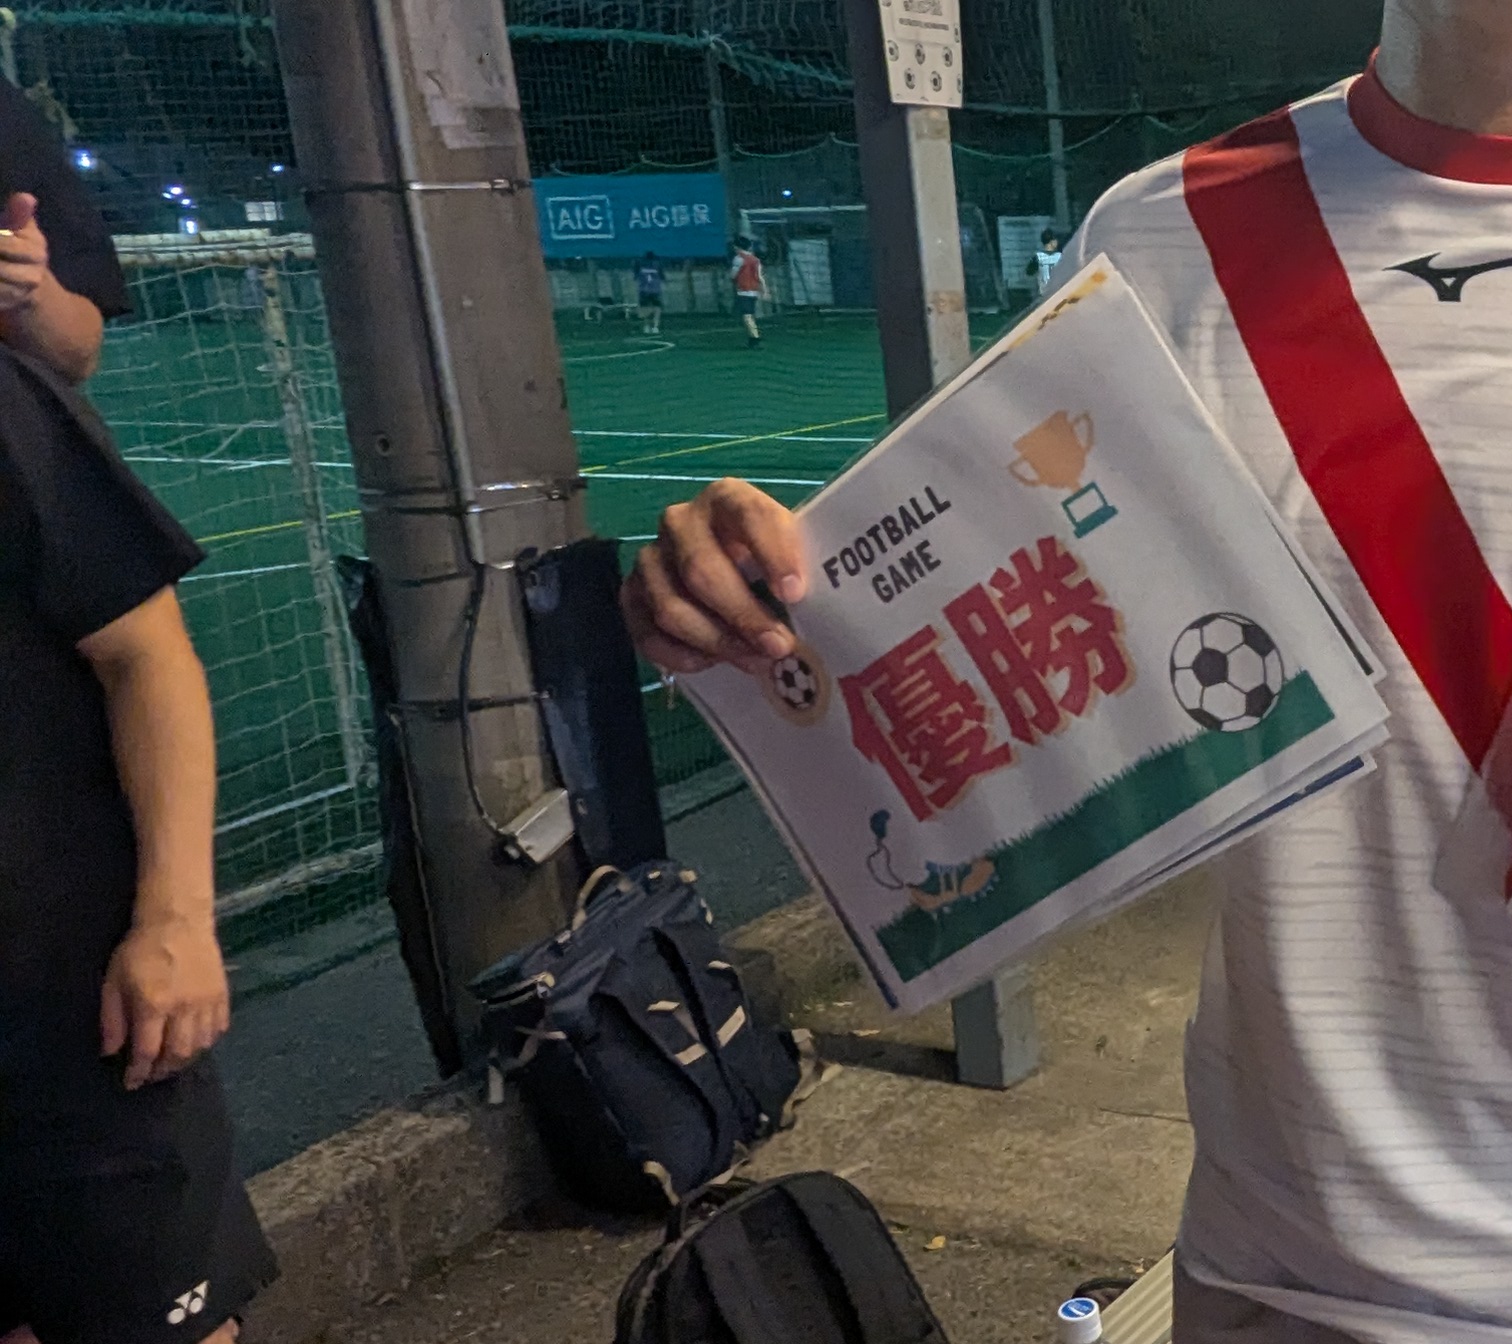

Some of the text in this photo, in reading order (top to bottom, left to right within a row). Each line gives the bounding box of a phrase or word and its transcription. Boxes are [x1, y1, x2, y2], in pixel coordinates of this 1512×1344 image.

[557, 204, 605, 232] AIG
[822, 485, 952, 589] FOOTBALL
[871, 539, 942, 603] GAME
[838, 535, 1137, 823] 優勝
